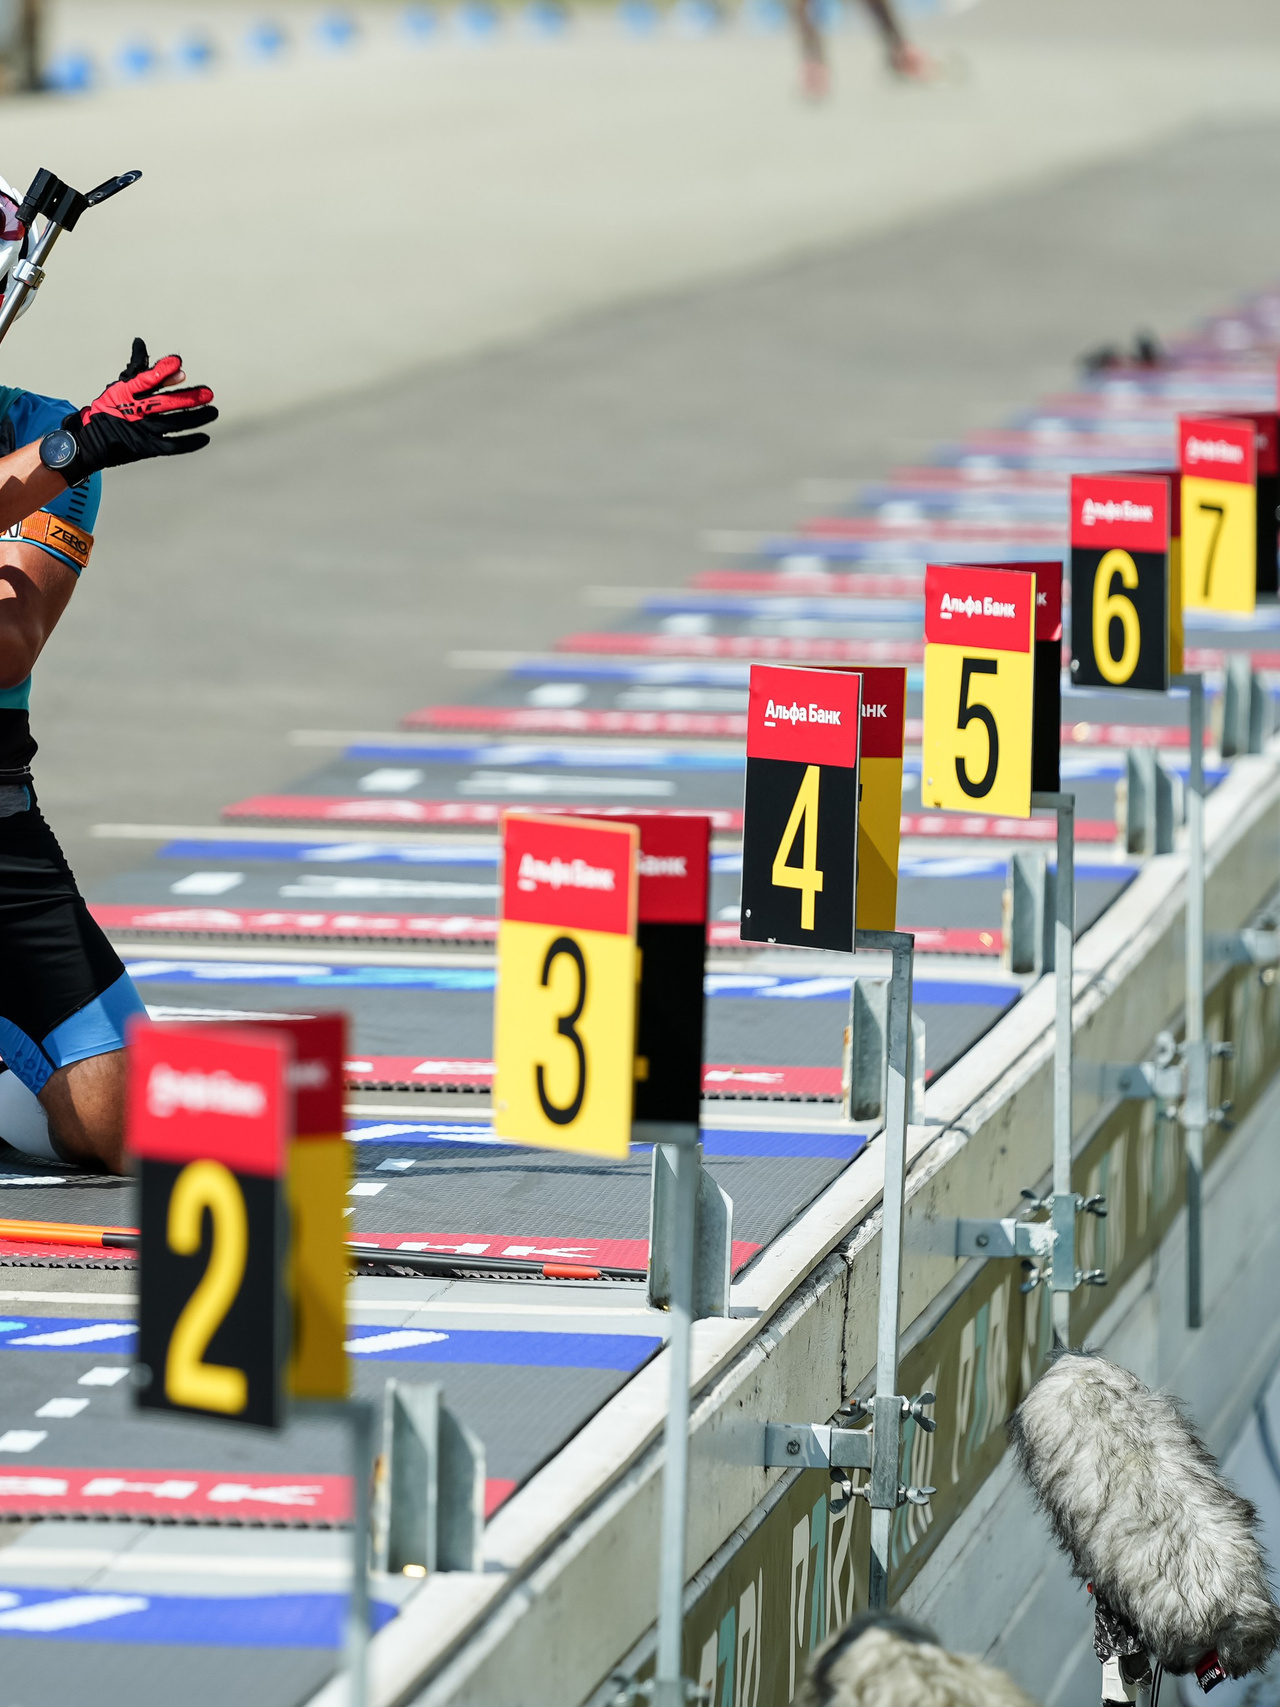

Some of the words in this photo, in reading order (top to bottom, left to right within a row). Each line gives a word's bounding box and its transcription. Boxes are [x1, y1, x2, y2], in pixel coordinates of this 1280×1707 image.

[50, 525, 88, 553] ZERO
[940, 592, 982, 618] Альфа
[983, 596, 1016, 618] Банк
[1199, 503, 1225, 598] 7
[1092, 548, 1141, 685] 6
[765, 699, 807, 726] Альфа
[808, 703, 842, 726] Банк
[955, 656, 999, 799] 5
[772, 764, 823, 930] 4
[535, 935, 588, 1125] 3
[166, 1158, 249, 1414] 2
